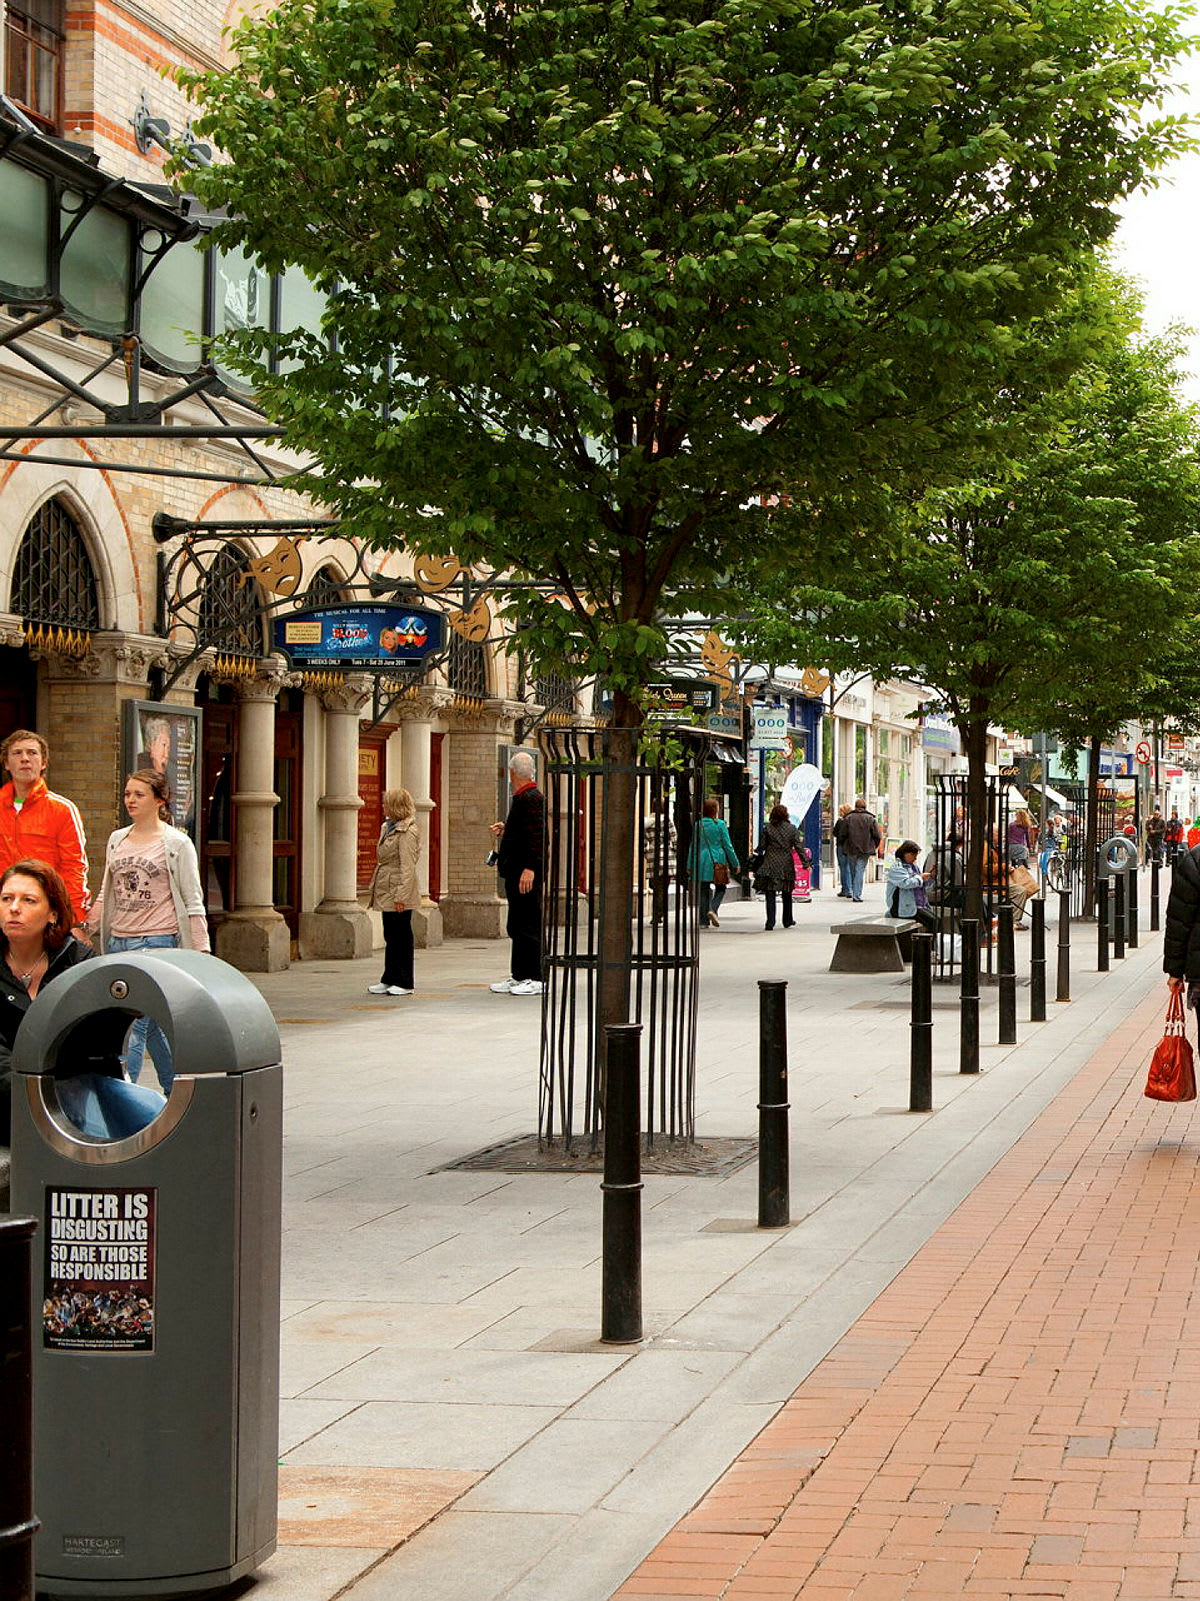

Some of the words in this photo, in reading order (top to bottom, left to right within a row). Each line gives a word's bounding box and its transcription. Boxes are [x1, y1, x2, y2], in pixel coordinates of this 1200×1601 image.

[332, 628, 368, 639] BLOOD
[139, 890, 151, 899] 76
[51, 1193, 119, 1218] LITTER
[124, 1194, 149, 1219] IS
[51, 1219, 148, 1240] DISGUSTING
[51, 1246, 68, 1261] SO
[70, 1247, 96, 1262] ARE
[99, 1247, 148, 1262] THOSE
[51, 1262, 148, 1281] RESPONSIBLE
